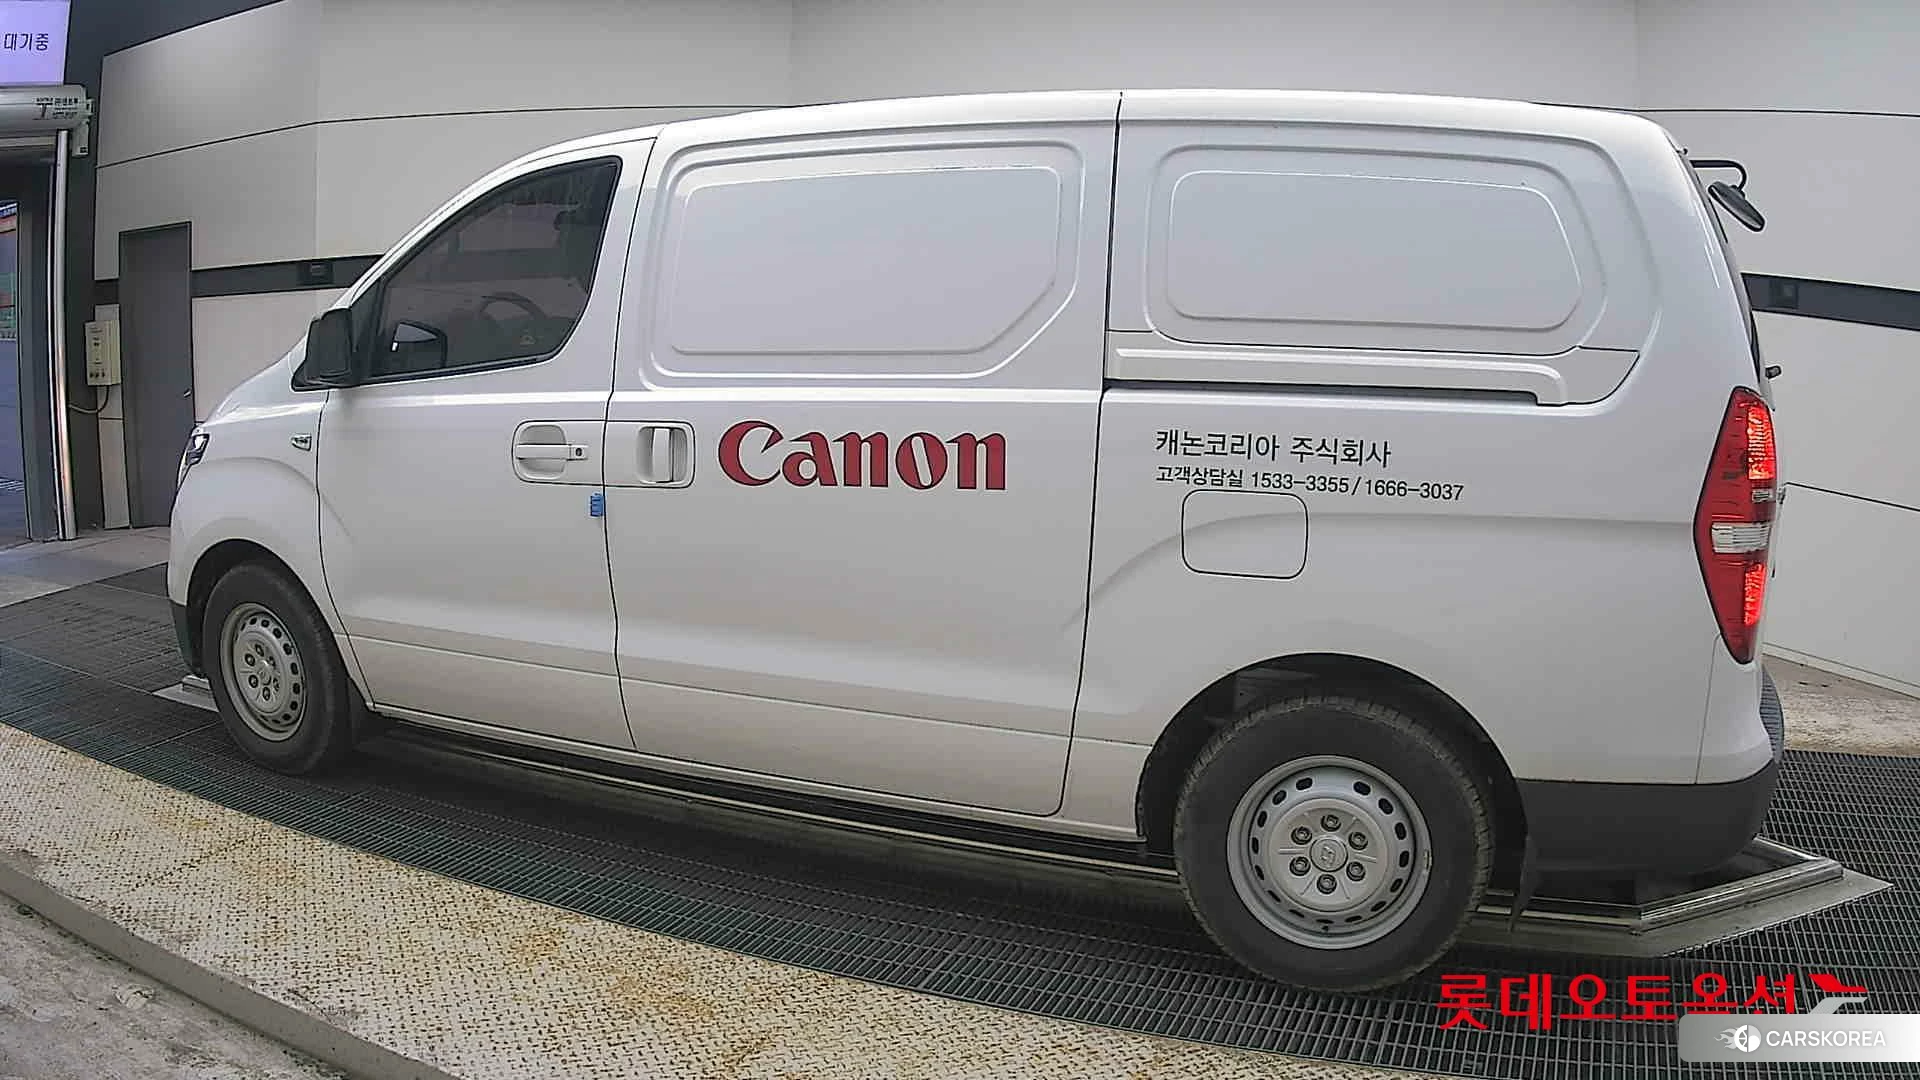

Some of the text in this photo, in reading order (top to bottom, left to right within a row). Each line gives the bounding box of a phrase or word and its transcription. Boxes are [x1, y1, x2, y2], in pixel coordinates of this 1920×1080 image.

[4, 33, 49, 51] 대기중
[718, 420, 1006, 490] Canon
[1155, 429, 1391, 468] 캐논코리아 주식회사
[1156, 465, 1243, 488] 고객상담실
